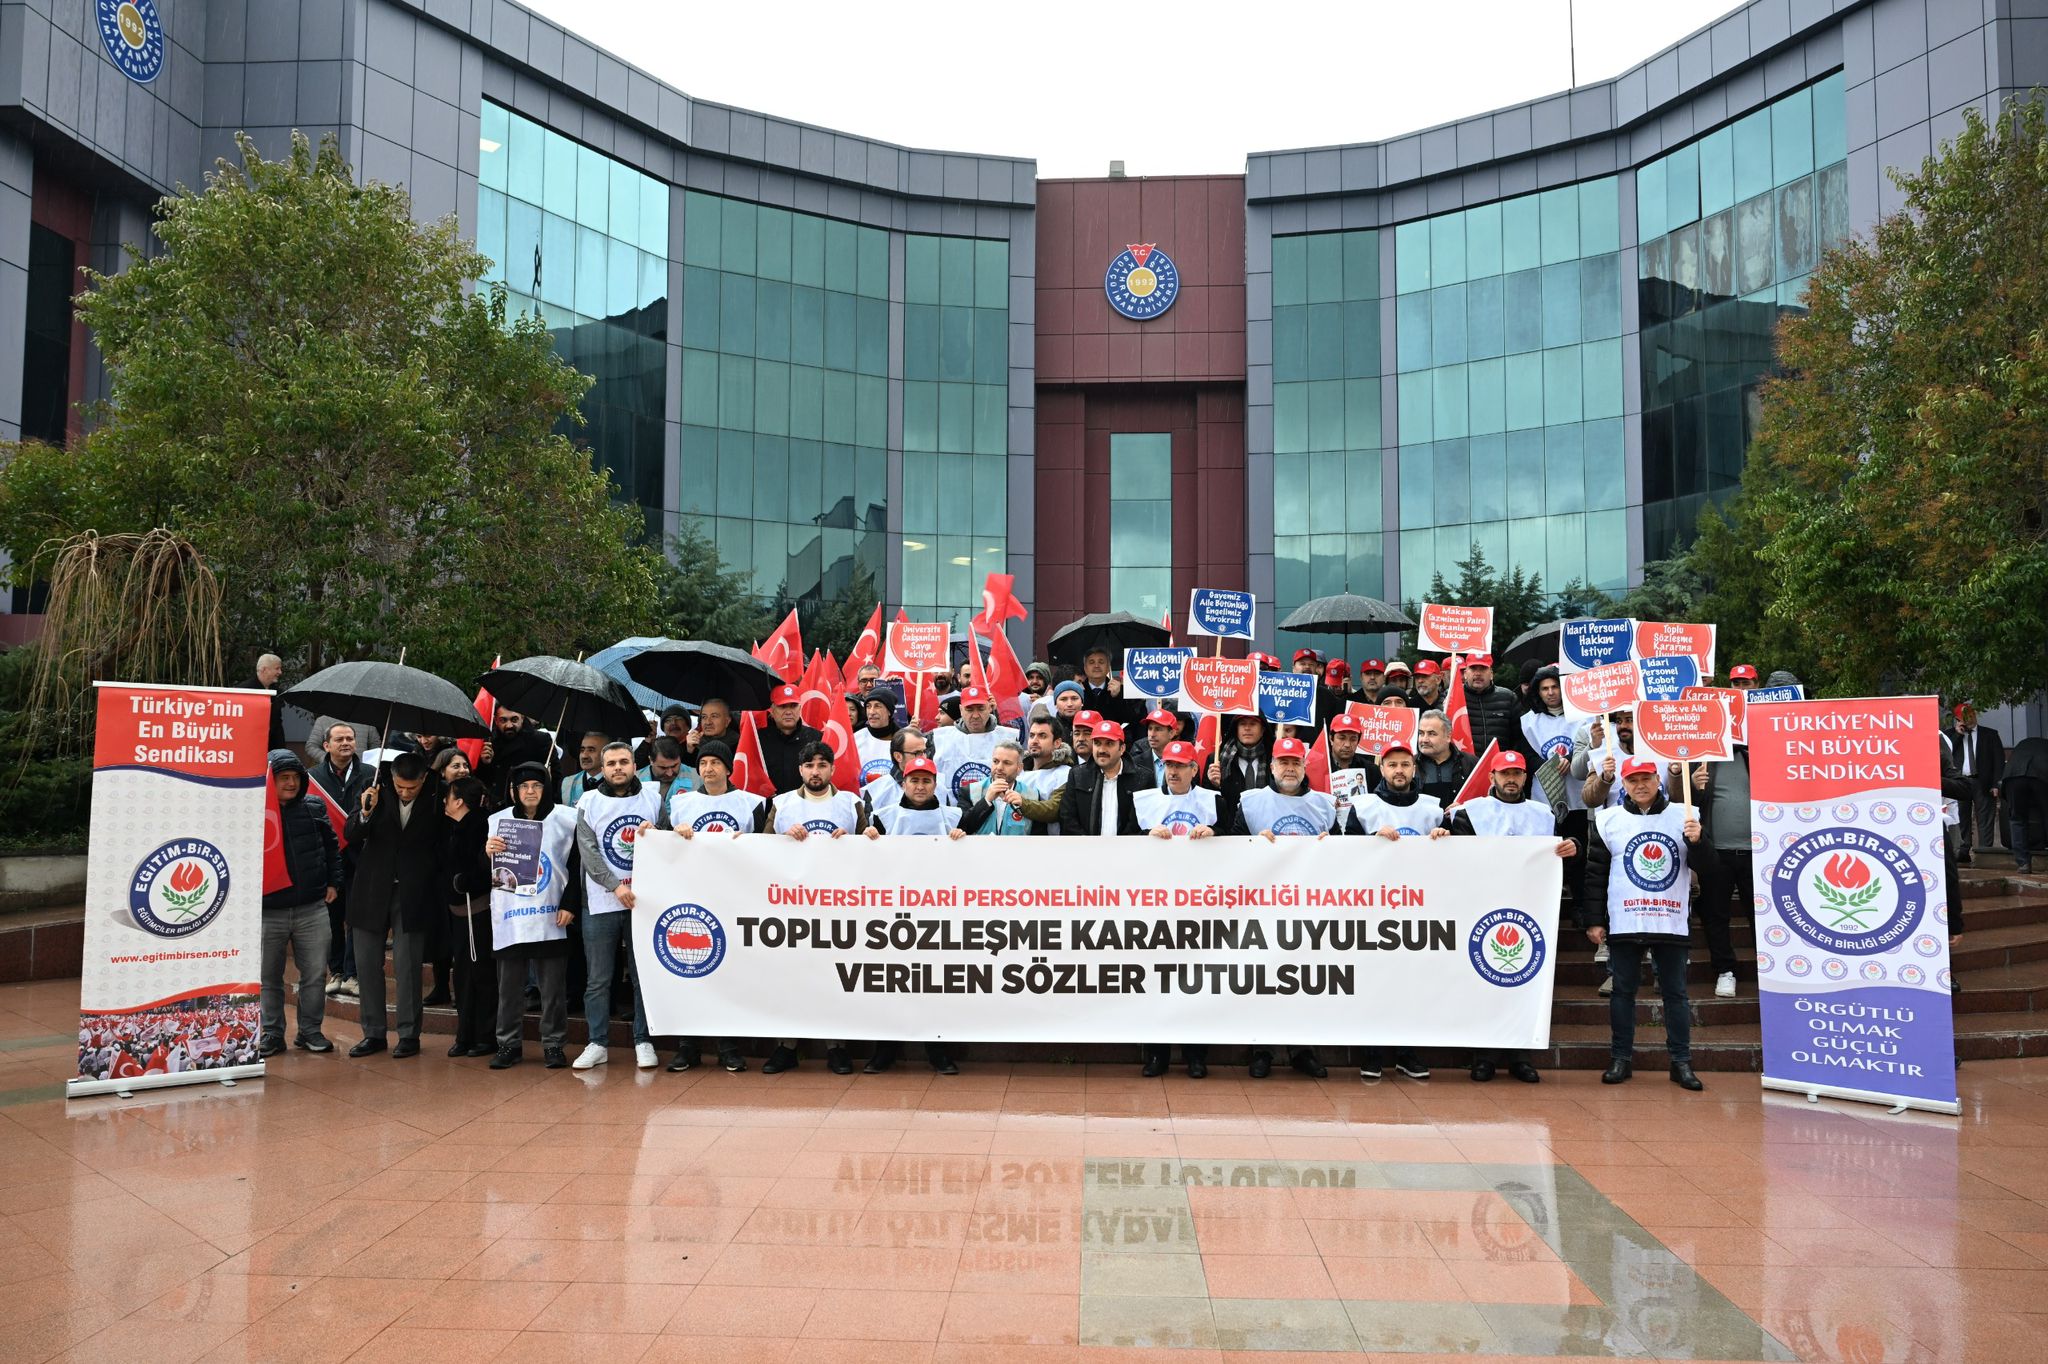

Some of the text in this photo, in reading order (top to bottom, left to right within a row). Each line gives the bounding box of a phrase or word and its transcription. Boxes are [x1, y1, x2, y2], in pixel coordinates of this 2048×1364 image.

[120, 13, 144, 39] 1992
[1129, 278, 1155, 286] 1992
[1209, 591, 1241, 600] Gayemiz
[1206, 607, 1241, 616] Engelimiz
[1442, 607, 1472, 616] Makam
[1567, 621, 1628, 635] İdari Personel
[1663, 625, 1684, 635] Toplu
[1579, 634, 1614, 645] Hakkını
[1654, 633, 1693, 644] Sözleşme
[1581, 645, 1613, 657] İstiyor
[1653, 642, 1692, 652] Kararına
[904, 650, 937, 659] Bekliyor
[1133, 651, 1189, 664] Akademik
[1191, 660, 1251, 674] İdari Personel
[1647, 658, 1669, 667] İdari
[1134, 666, 1181, 682] Zam Şar
[1196, 672, 1245, 686] Üvey Evlat
[1570, 664, 1633, 685] Yer Değişikliği
[1641, 667, 1679, 678] Personel
[1287, 677, 1310, 688] Yoksa
[1571, 675, 1634, 696] Hakkı Adaleti
[1647, 677, 1676, 685] Robot
[1203, 686, 1237, 698] Değildir
[1260, 685, 1307, 698] Mücadele
[1588, 688, 1619, 702] Sağlar
[1647, 685, 1680, 695] Değildir
[1686, 690, 1715, 701] Karar
[130, 696, 244, 719] Türkiye'nin
[1274, 697, 1292, 707] Var
[1653, 704, 1677, 714] Sağlık
[1691, 704, 1708, 713] Aile
[1373, 708, 1389, 719] Yer
[1661, 714, 1701, 723] Bütünlüğü
[1769, 710, 1914, 731] TÜRKİYE'NİN
[139, 720, 234, 743] En Büyük
[1664, 723, 1698, 731] Bizimde
[1363, 730, 1394, 742] Haktır
[1647, 731, 1717, 741] Mazeretimizdir
[1786, 735, 1900, 756] EN BÜYÜK
[134, 744, 234, 764] Sendikası
[1786, 760, 1905, 780] SENDİKASI
[1777, 832, 1919, 886] EĞİTİM-BİR-SEN
[135, 842, 228, 893] EĞİTİM-BİR-SEN
[767, 883, 1424, 909] ÜNİVERSİTE İDARİ PERSONELİNİN YER DEĞİŞİKLİĞİ HAKKI İÇİN
[137, 907, 176, 934] EĞİTİMCİLER
[660, 907, 718, 930] MEMUR-SEN
[1781, 894, 1917, 950] EĞİTİMCİLER BİRLİĞİ SENDİKASI
[736, 912, 1456, 957] TOPLU SÖZLEŞME KARARINA UYULSUN
[110, 948, 240, 964] www.egitimbirsen.org.tr
[835, 957, 1355, 996] VERİLEN SÖZLER TUTULSUN
[1794, 997, 1914, 1022] ÖRGÜTLÜ
[1808, 1018, 1902, 1040] OLMAK
[1813, 1035, 1898, 1055] GÜÇLÜ
[1791, 1050, 1924, 1077] OLMAKTIR
